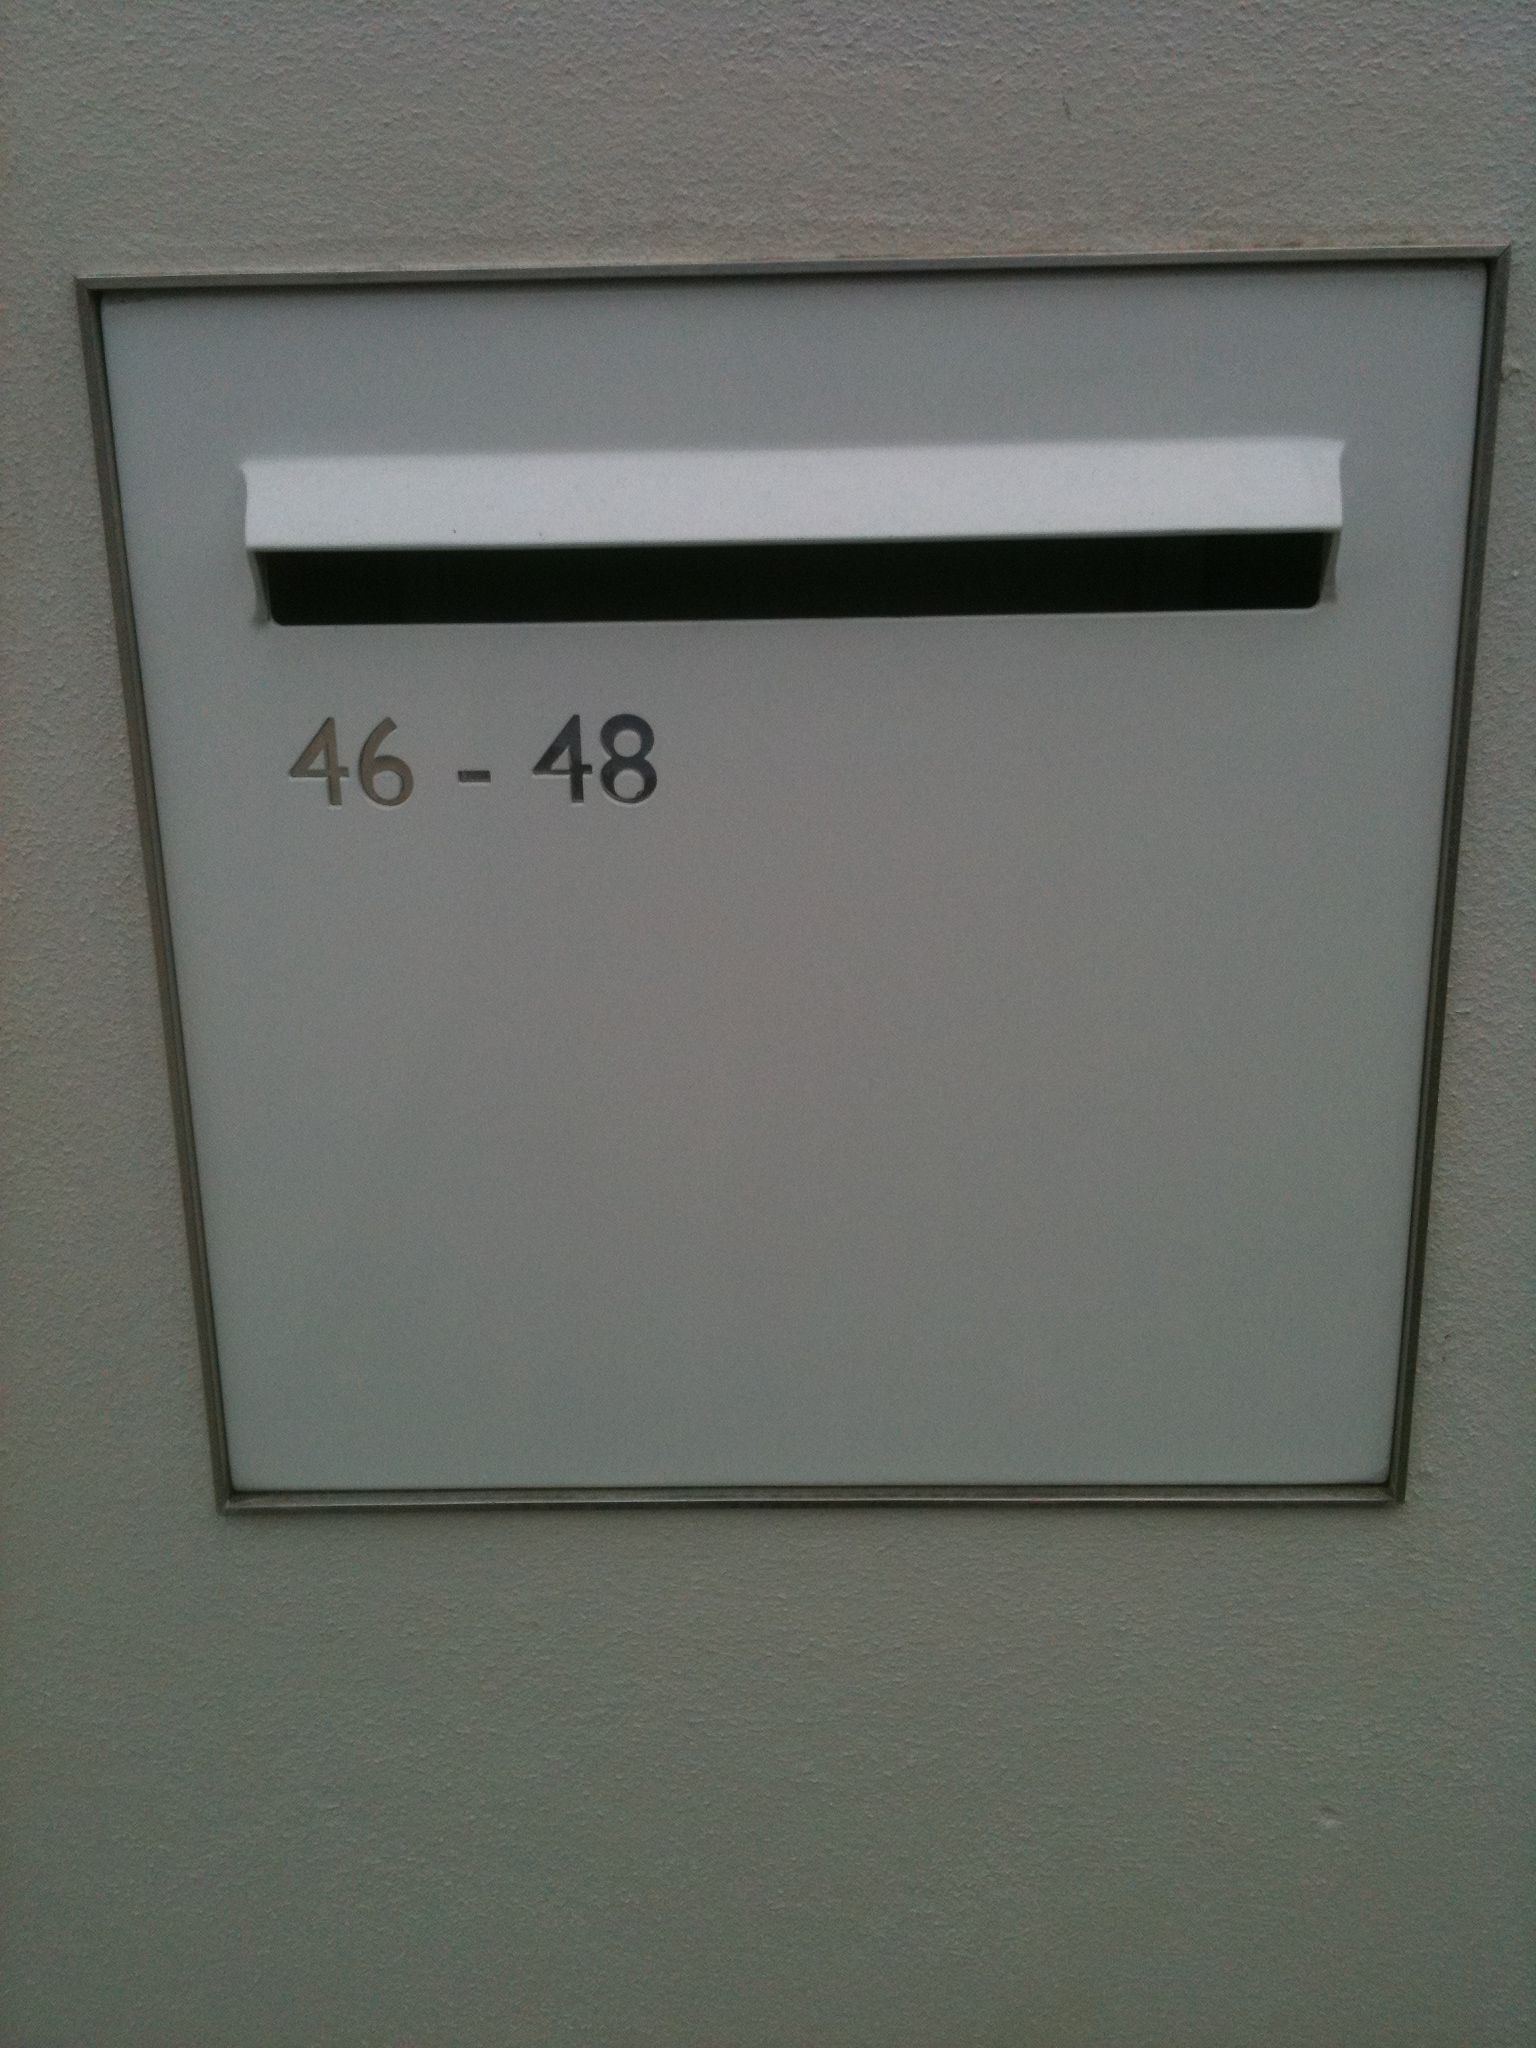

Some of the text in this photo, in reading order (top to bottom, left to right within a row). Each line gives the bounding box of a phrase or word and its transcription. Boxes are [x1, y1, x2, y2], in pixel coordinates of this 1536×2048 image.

[289, 713, 658, 806] 46 - 48
